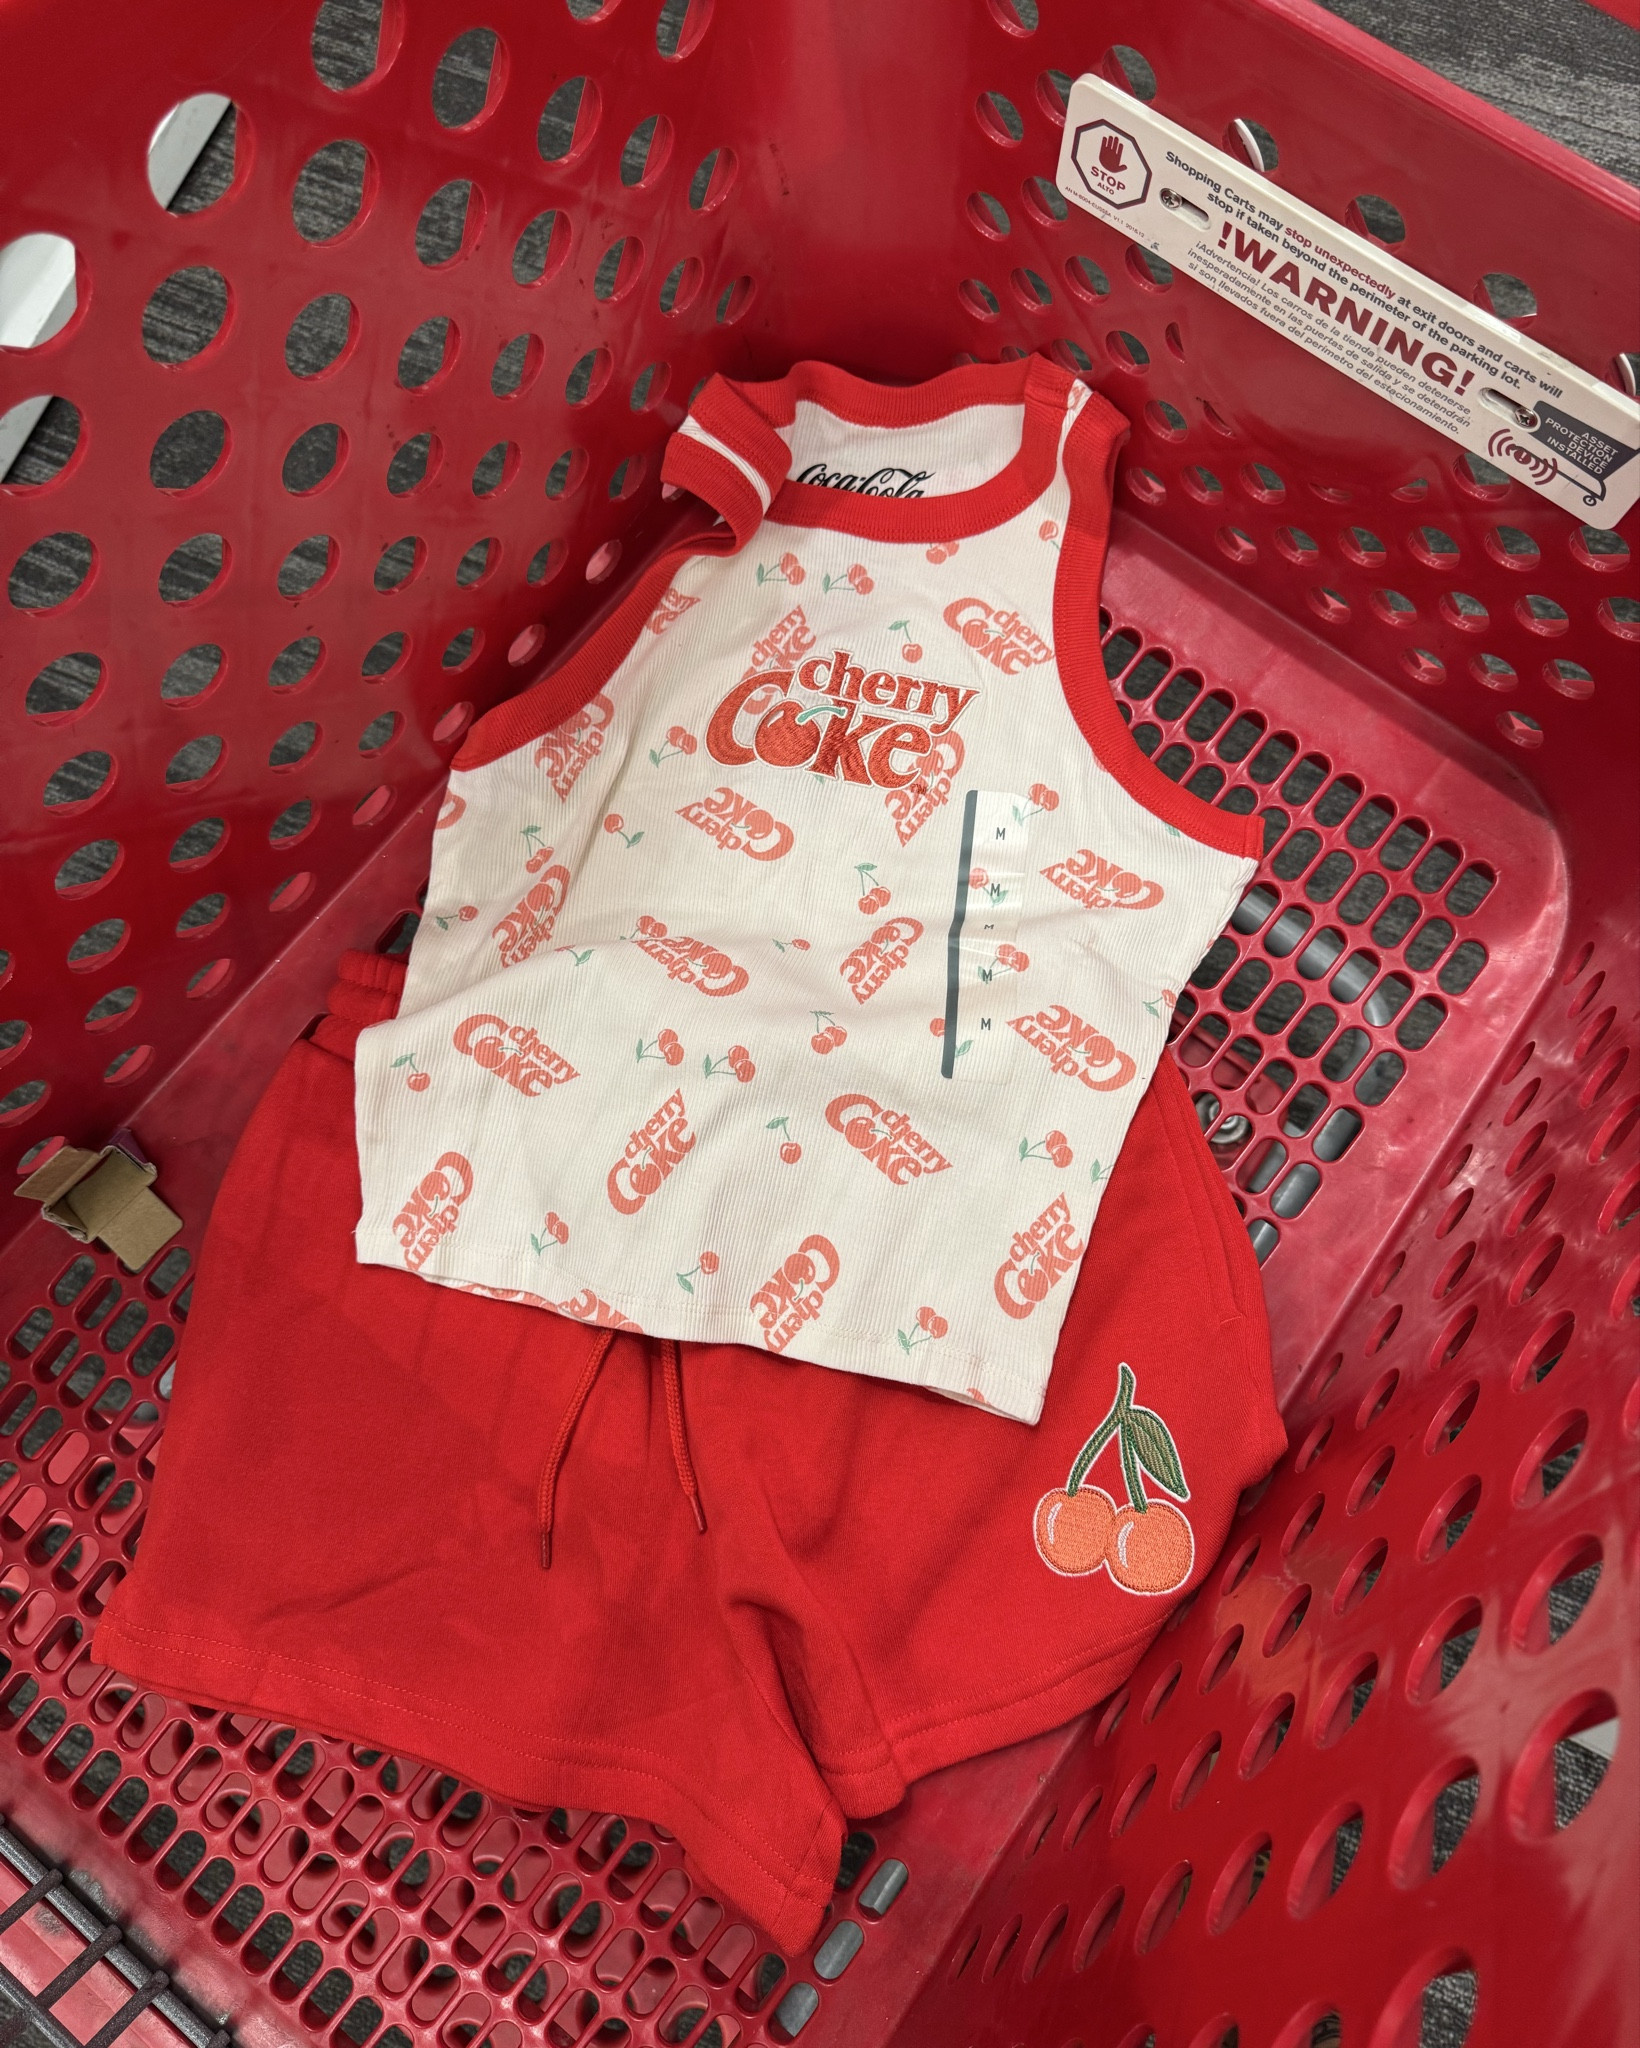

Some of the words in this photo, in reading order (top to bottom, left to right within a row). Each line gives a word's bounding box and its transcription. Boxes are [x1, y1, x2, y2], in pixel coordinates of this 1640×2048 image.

[1089, 165, 1126, 191] STOP
[1096, 181, 1115, 196] ALTO
[1165, 150, 1222, 194] Shopping
[1223, 187, 1256, 214] Carts
[1257, 209, 1284, 232] may
[1283, 226, 1312, 248] stop
[1313, 244, 1396, 300] unexpectedly
[1396, 296, 1412, 309] at
[1411, 305, 1437, 324] exit
[1437, 320, 1476, 347] doors
[1476, 343, 1504, 363] and
[1503, 360, 1537, 384] carts
[1538, 379, 1563, 399] will
[1206, 192, 1234, 214] stop
[1235, 208, 1246, 221] if
[1246, 215, 1280, 243] taken
[1281, 237, 1327, 272] beyond
[1327, 266, 1349, 286] the
[1348, 281, 1411, 322] perimeter
[1411, 319, 1428, 332] of
[1427, 327, 1449, 346] the
[1448, 342, 1499, 377] parking
[1500, 370, 1521, 390] lot.
[1186, 247, 1272, 306] inesperadamente
[1272, 304, 1287, 316] en
[1286, 311, 1304, 326] las
[1302, 323, 1344, 351] puertas
[1344, 349, 1360, 361] de
[1359, 358, 1393, 381] salida
[1391, 377, 1402, 386] y
[1401, 383, 1416, 395] se
[1416, 392, 1471, 428] detendrán
[1195, 239, 1261, 286] ¡Advertencia!
[1260, 282, 1280, 299] Los
[1280, 296, 1314, 320] carros
[1314, 317, 1329, 330] de
[1329, 325, 1341, 337] la
[1341, 333, 1375, 358] tienda
[1374, 355, 1417, 383] pueden
[1417, 380, 1471, 415] detenerse
[1217, 220, 1476, 397] !WARNING!
[1187, 261, 1199, 271] si
[1197, 268, 1217, 284] son
[1217, 279, 1259, 310] llevados
[1259, 306, 1286, 328] fuera
[1287, 325, 1306, 339] del
[1303, 336, 1354, 370] perímetro
[1355, 367, 1374, 381] del
[1373, 378, 1459, 435] estacionamiento.
[1544, 416, 1613, 463] PROTECTION
[1546, 435, 1603, 474] INSTALLED
[1566, 440, 1608, 469] DEVICE
[1580, 431, 1619, 456] ASSET
[752, 604, 807, 666] cherry
[797, 649, 982, 735] cherry
[552, 731, 604, 804] cherry
[674, 802, 742, 850] cherry
[895, 777, 951, 848] cherry
[995, 827, 1006, 840] M
[990, 883, 1000, 896] M
[1039, 863, 1112, 909] cherry
[851, 945, 909, 1005] cherry
[982, 969, 992, 982] M
[508, 1025, 581, 1084] cherry
[980, 1018, 991, 1031] M
[1005, 1015, 1079, 1076] cherry
[625, 1087, 685, 1159] cherry
[881, 1110, 954, 1174] cherry
[1009, 1191, 1071, 1262] cherry
